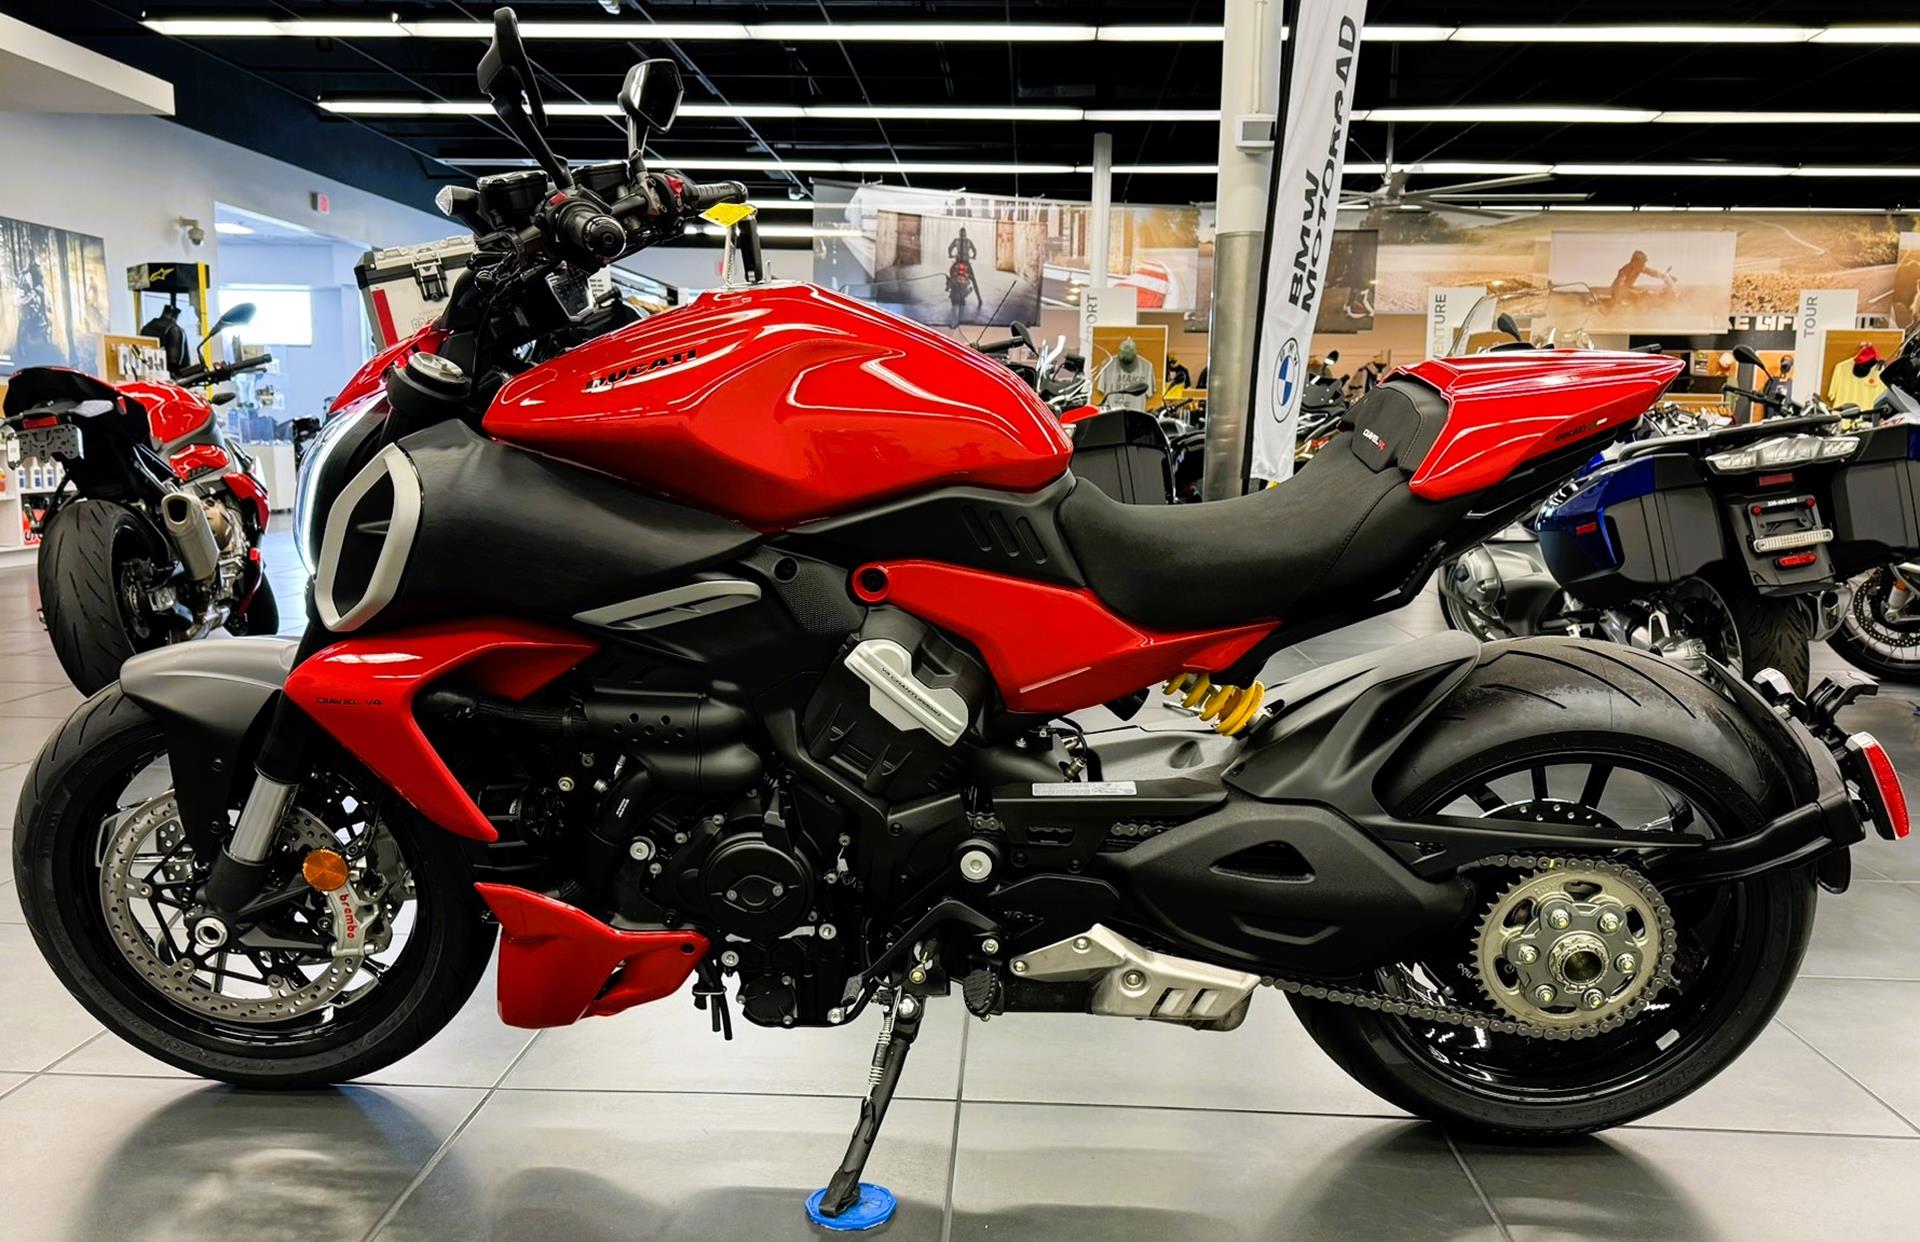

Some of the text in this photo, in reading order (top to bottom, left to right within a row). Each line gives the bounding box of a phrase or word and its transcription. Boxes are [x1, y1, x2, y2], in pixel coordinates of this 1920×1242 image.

[1289, 169, 1320, 307] BMW
[1804, 296, 1818, 338] TOUR
[585, 350, 696, 393] DUCATI
[1555, 425, 1587, 441] DUCATI
[339, 893, 358, 939] brembo
